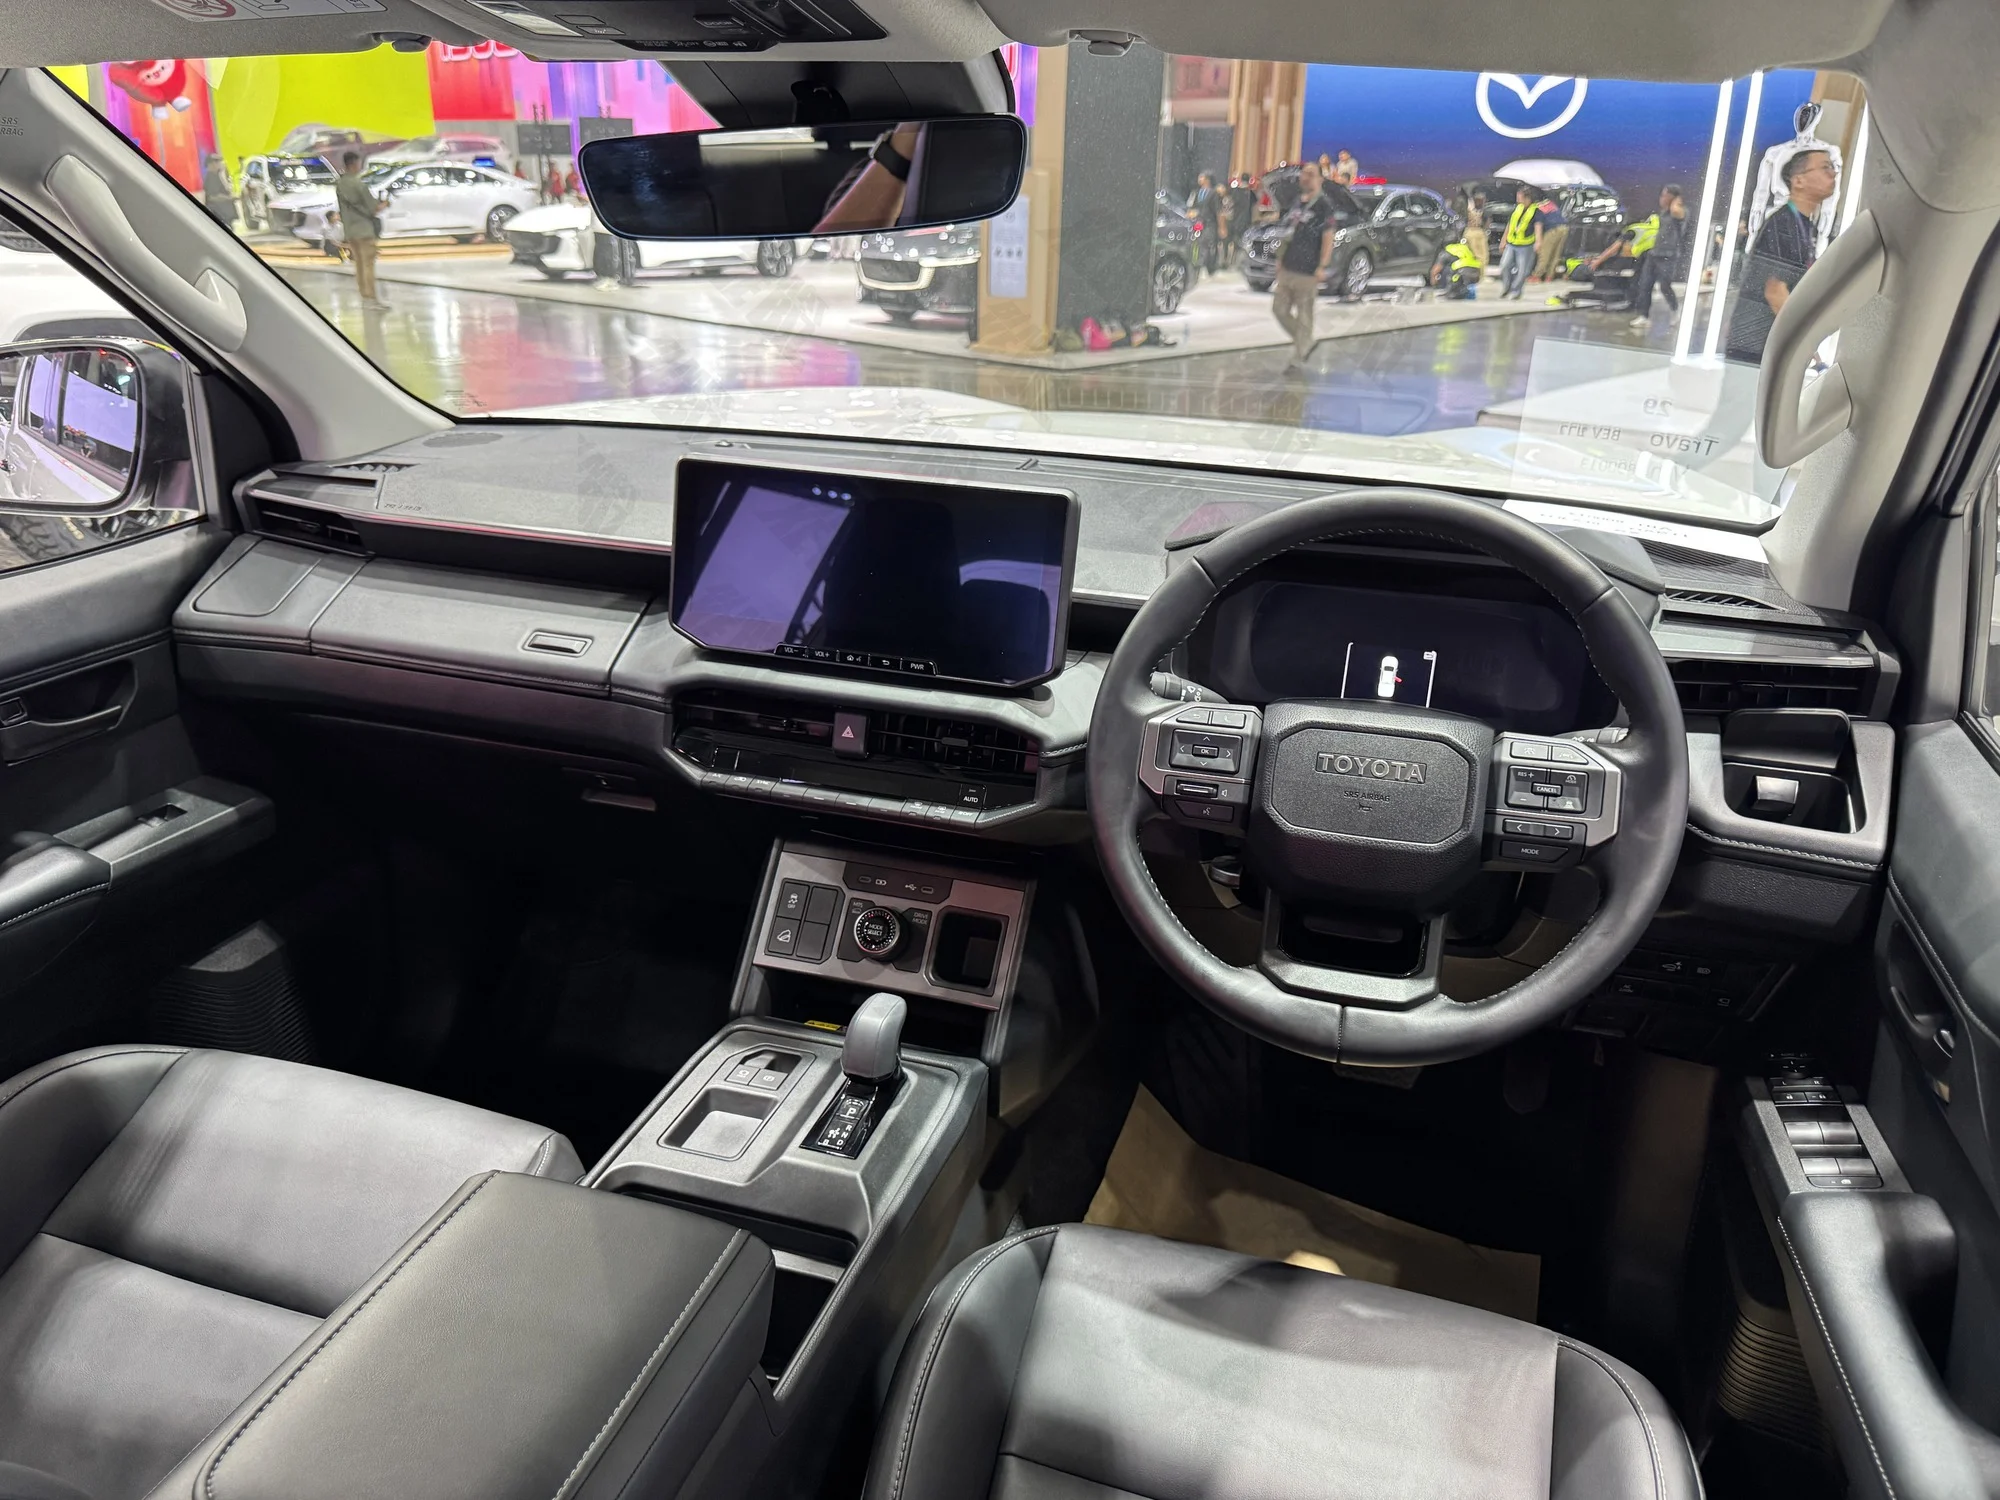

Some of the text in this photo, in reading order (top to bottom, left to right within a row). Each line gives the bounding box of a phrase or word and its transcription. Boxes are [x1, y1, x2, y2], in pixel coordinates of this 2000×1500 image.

[1, 116, 18, 125] SRS
[0, 127, 24, 136] RBAG
[815, 650, 830, 658] VOL+
[910, 663, 925, 671] PWR
[1319, 753, 1424, 784] TOYOTA
[1536, 786, 1557, 794] CANCEL
[963, 795, 979, 803] AUTO
[1343, 790, 1390, 802] SRS AIRBAG
[1520, 847, 1540, 855] MODE
[847, 1107, 857, 1117] P
[845, 1124, 853, 1132] R
